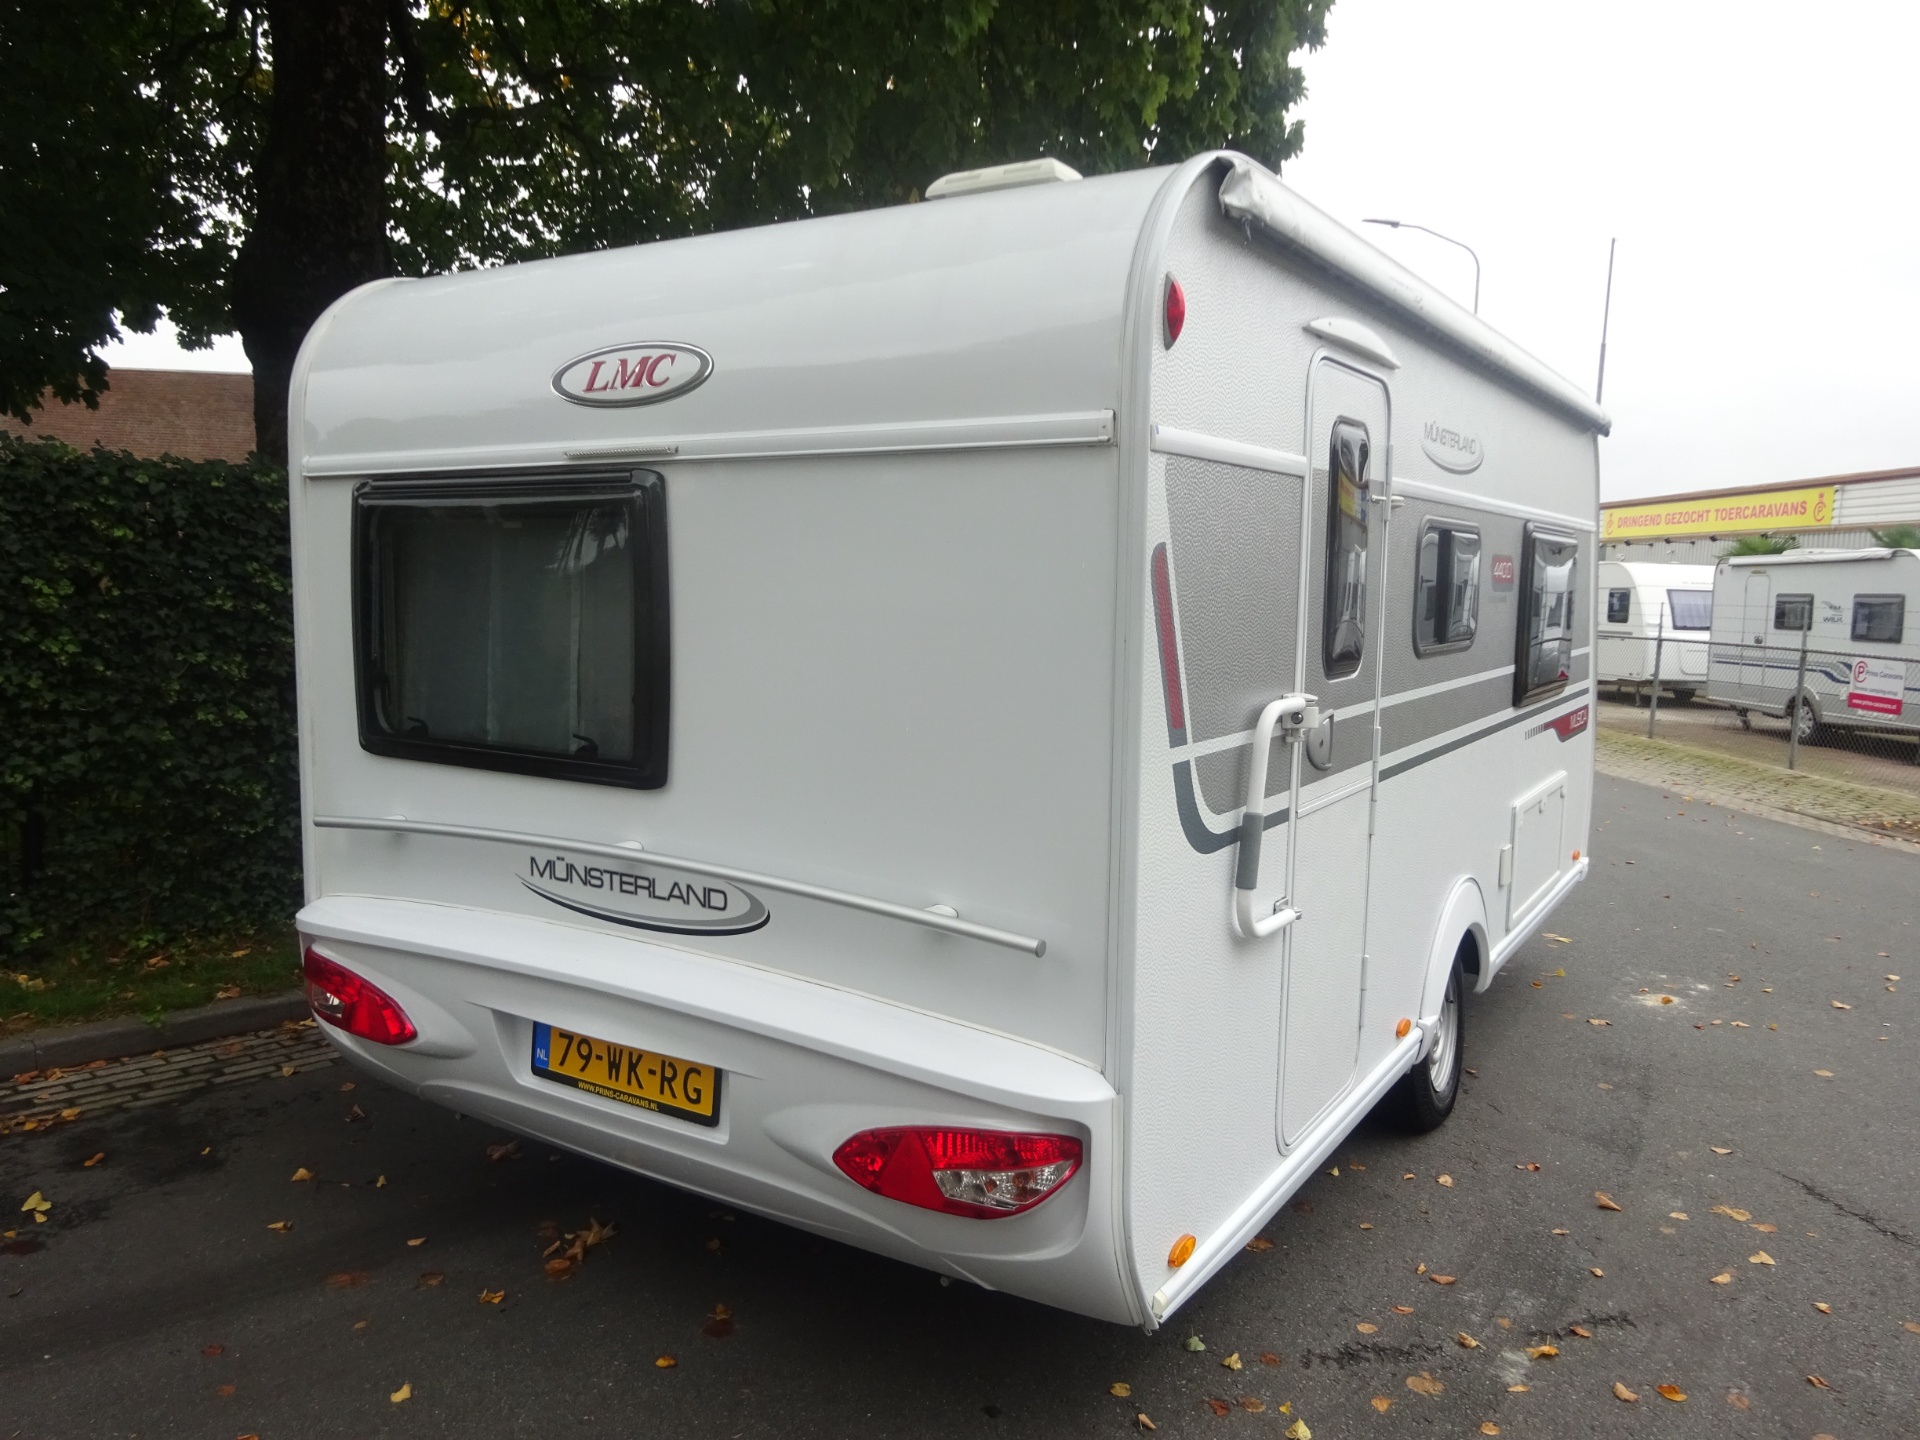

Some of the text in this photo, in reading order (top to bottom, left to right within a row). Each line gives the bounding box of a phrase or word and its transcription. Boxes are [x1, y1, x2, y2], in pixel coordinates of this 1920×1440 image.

[582, 353, 677, 393] LMC
[1617, 513, 1661, 529] DRINGEND
[1664, 509, 1711, 526] GEZOCHT
[1714, 501, 1808, 522] TOERCARAVANS
[529, 855, 728, 912] MÜNSTERLAND
[536, 1032, 703, 1105] NL 79-WK-RG
[577, 1081, 659, 1112] WWW.PRINS-CARAVANS.NL
